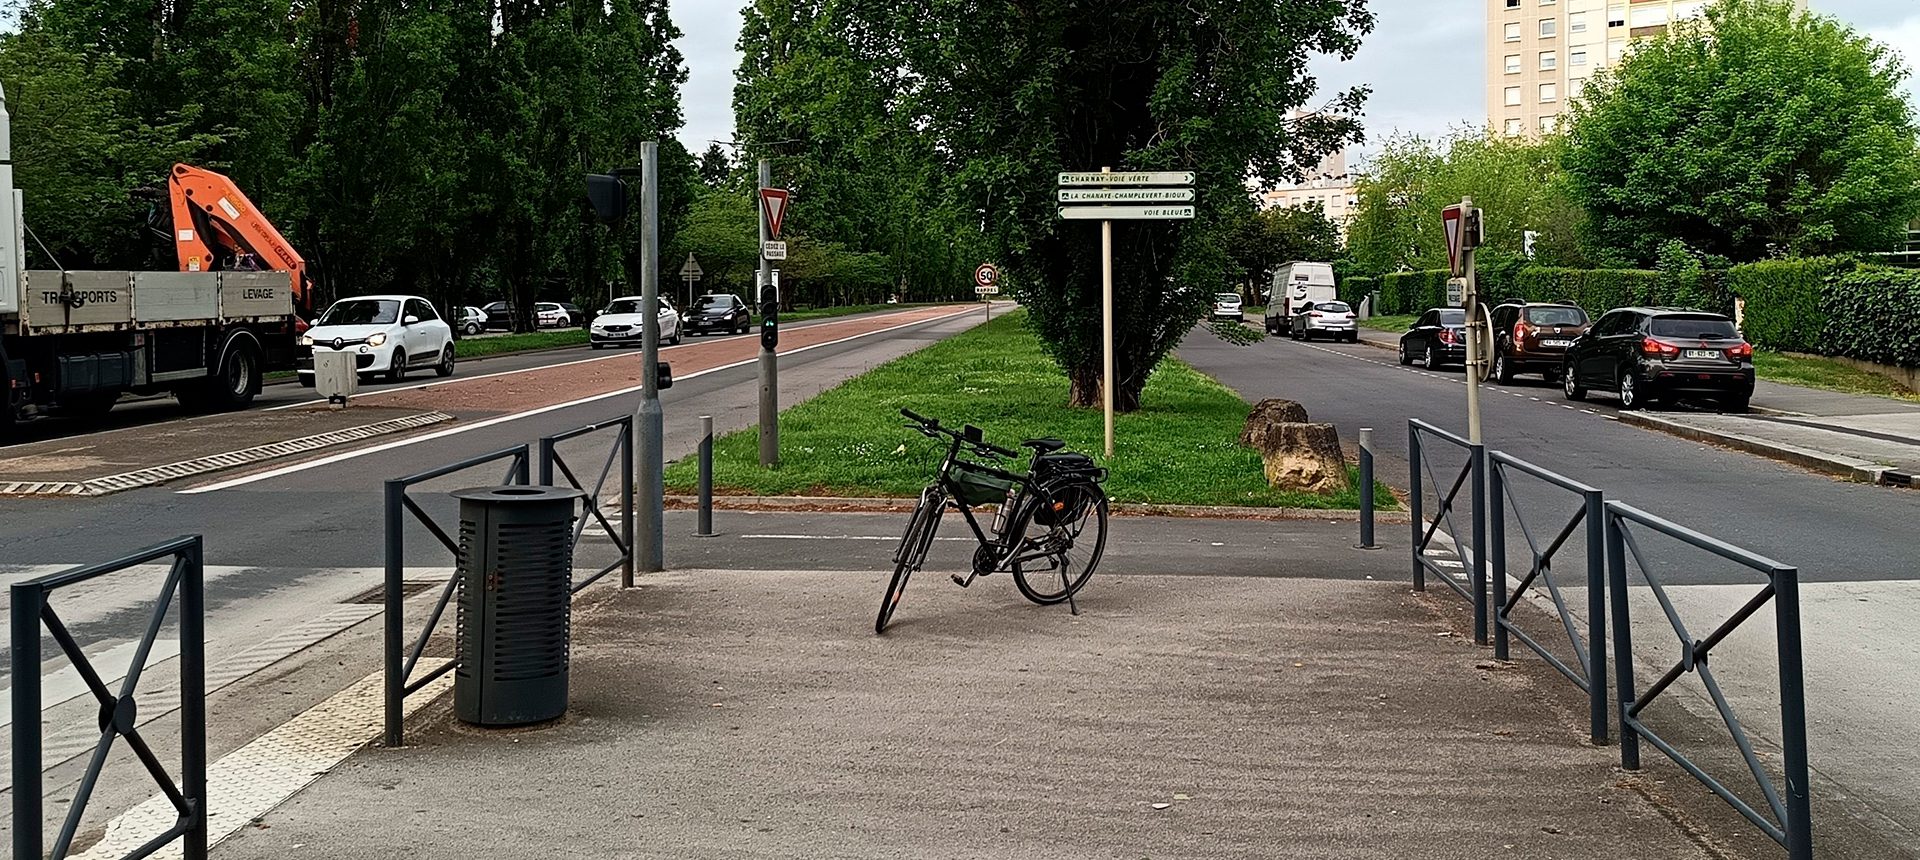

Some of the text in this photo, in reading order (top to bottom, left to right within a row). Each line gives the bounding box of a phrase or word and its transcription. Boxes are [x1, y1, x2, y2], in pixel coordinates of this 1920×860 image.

[980, 271, 993, 281] 50
[42, 290, 117, 304] TRSPORTS
[242, 288, 274, 299] LEVAGE
